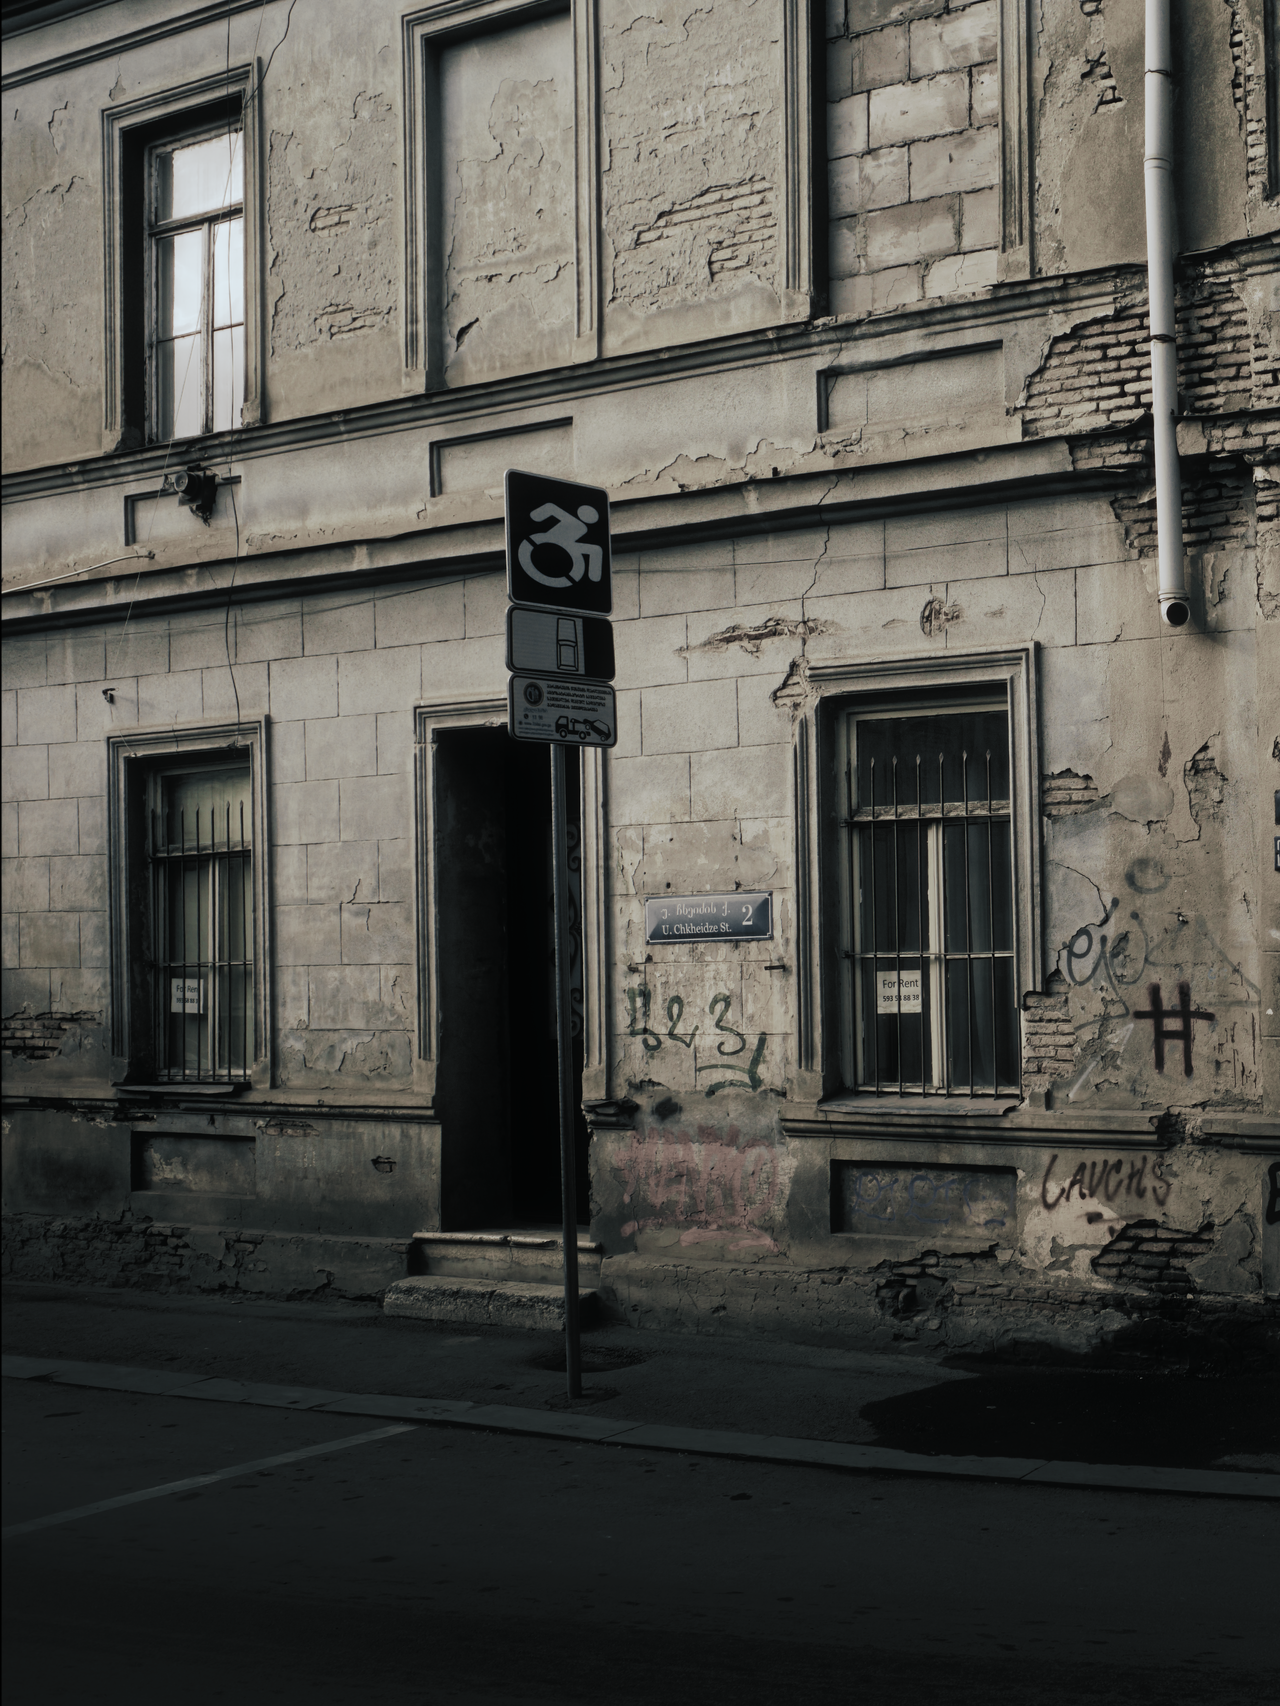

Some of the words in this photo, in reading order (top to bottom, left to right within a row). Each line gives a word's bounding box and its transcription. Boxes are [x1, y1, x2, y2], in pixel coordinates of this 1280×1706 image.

[741, 904, 753, 926] 2
[661, 924, 673, 935] U.
[673, 922, 719, 935] Chkheidze
[719, 921, 732, 933] St.
[883, 980, 896, 988] For
[899, 979, 919, 988] Rent
